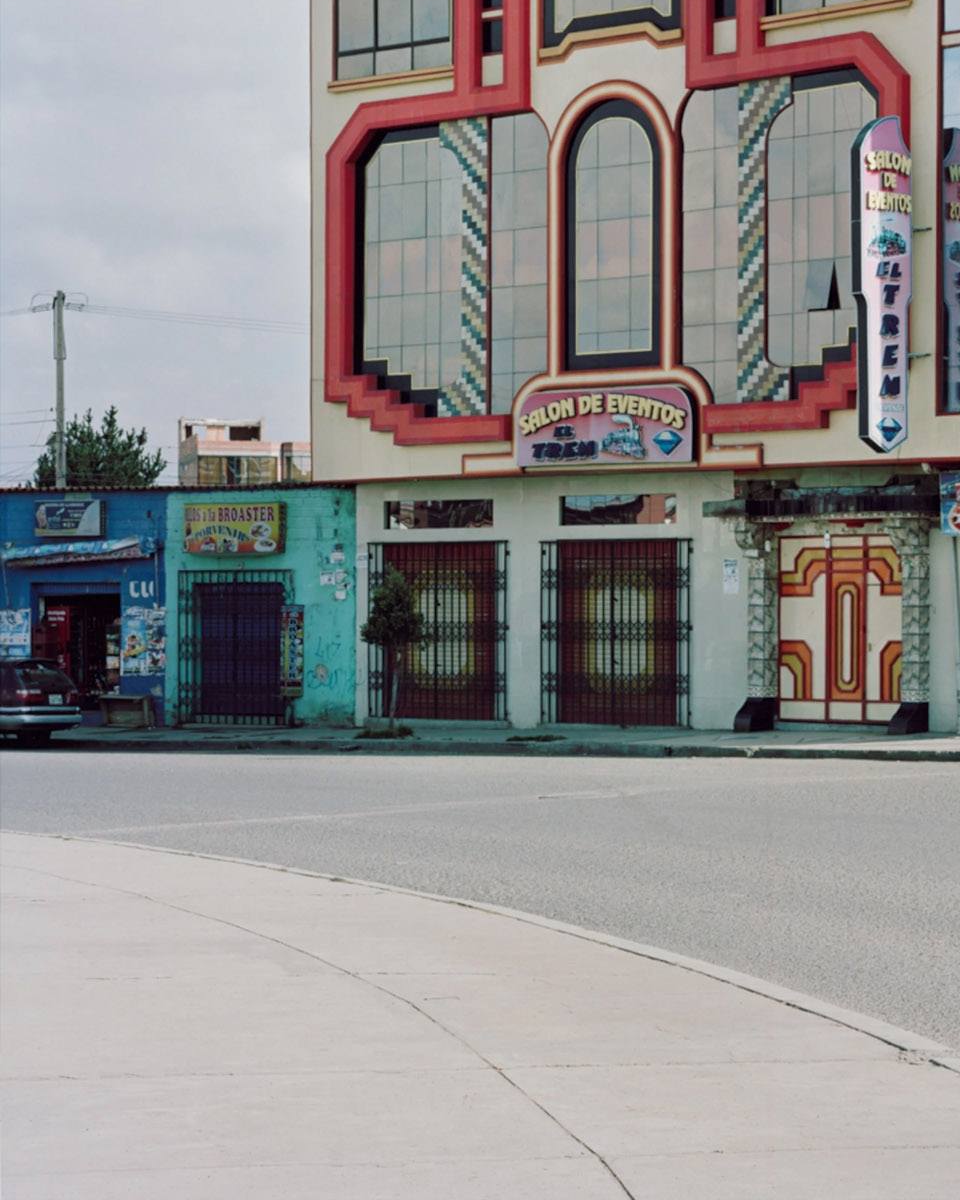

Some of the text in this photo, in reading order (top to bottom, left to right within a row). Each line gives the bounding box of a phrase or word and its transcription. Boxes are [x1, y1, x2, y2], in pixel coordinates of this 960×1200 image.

[864, 150, 912, 176] SALON
[881, 172, 897, 190] DE
[866, 191, 912, 215] EVENTOS
[876, 261, 902, 279] EL
[880, 284, 901, 398] TREN
[519, 393, 687, 436] SALON DE EVENTOS
[532, 440, 600, 461] TREN
[218, 506, 274, 521] BROASTER
